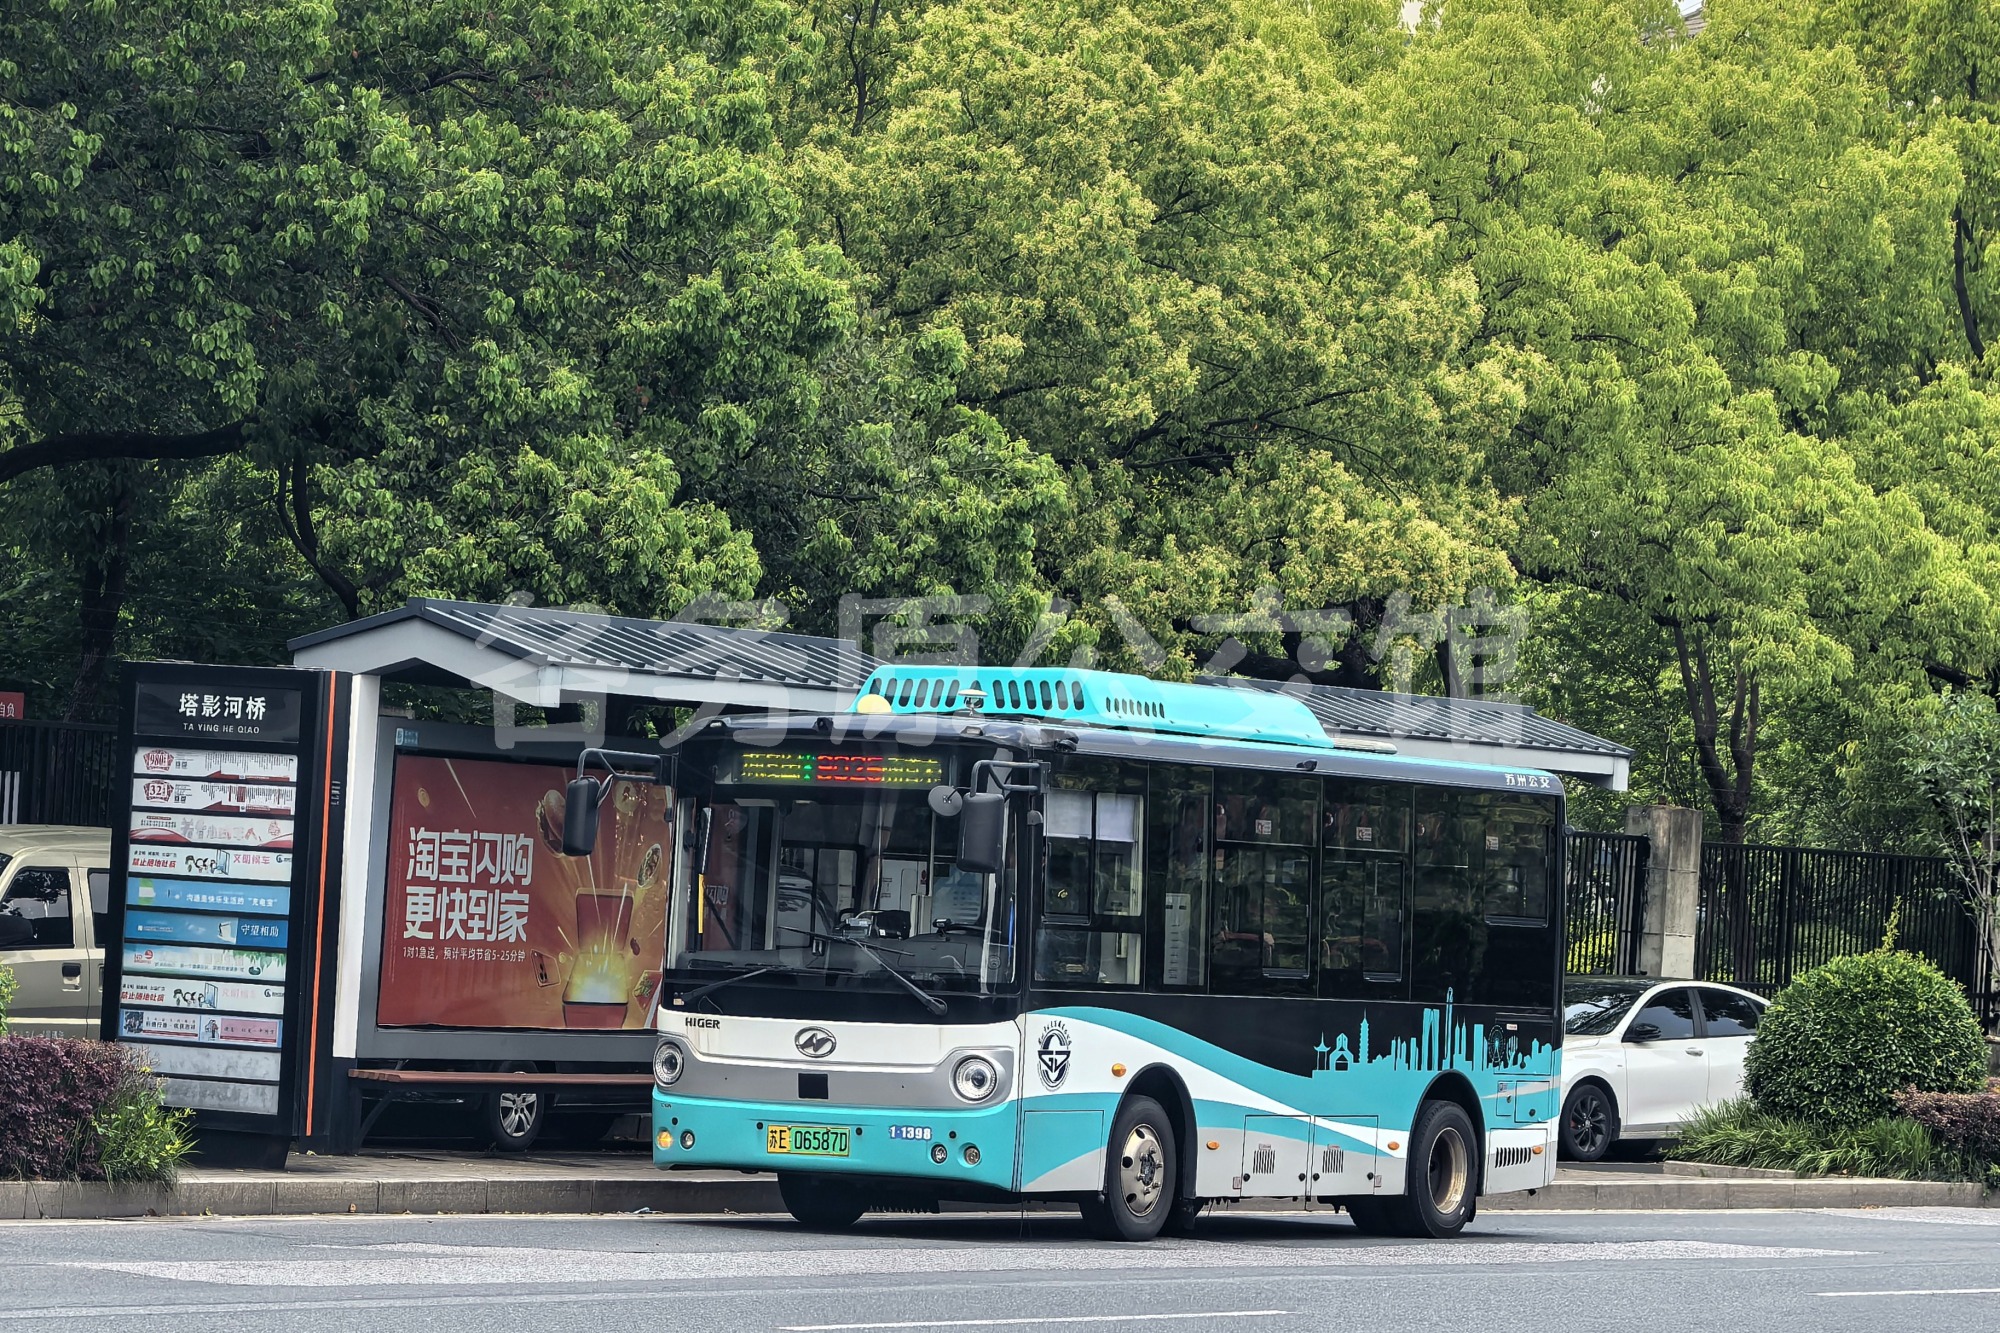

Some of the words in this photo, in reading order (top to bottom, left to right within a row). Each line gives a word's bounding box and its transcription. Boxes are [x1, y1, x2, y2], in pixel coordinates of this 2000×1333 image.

[178, 693, 267, 721] 塔影河桥
[183, 723, 194, 731] TA
[198, 723, 219, 733] YING
[222, 724, 234, 733] HE
[237, 725, 260, 734] QIAO
[1504, 773, 1551, 788] 苏州公交
[149, 785, 162, 795] 32
[405, 826, 534, 886] 淘宝闪购
[403, 885, 530, 943] 更快到家
[240, 924, 279, 937] 守望相助
[685, 1017, 721, 1029] HIGER
